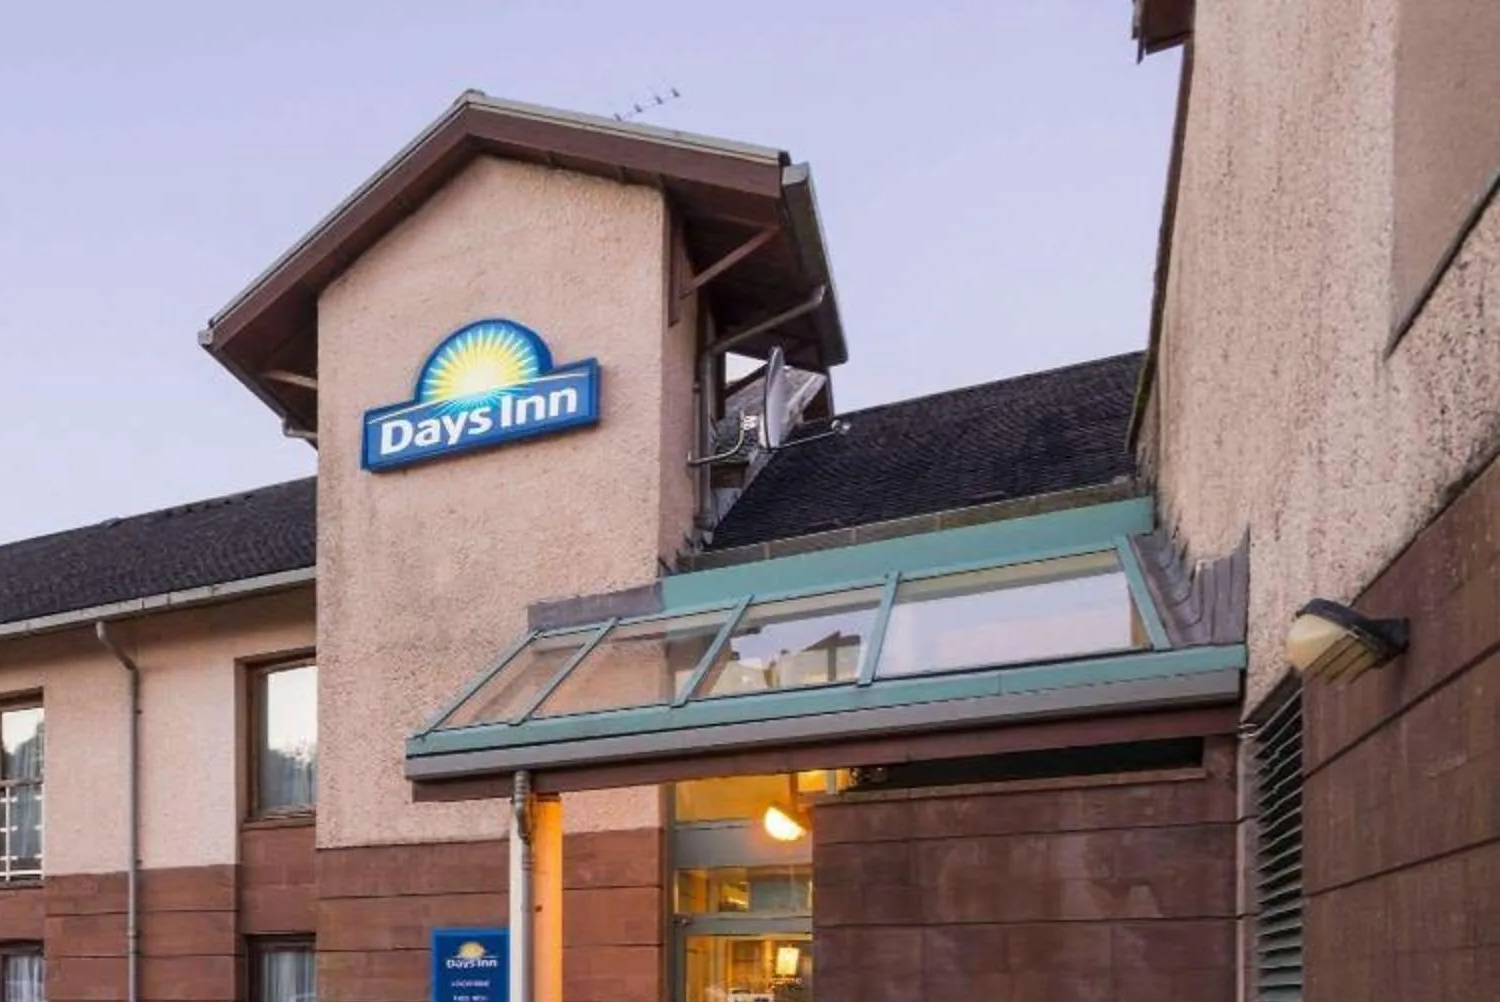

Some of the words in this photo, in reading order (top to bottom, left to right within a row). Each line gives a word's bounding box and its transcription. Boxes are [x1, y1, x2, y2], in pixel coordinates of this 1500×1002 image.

[380, 405, 493, 456] Days
[500, 386, 578, 428] Inn
[446, 959, 476, 969] Days
[477, 959, 497, 968] Inn
